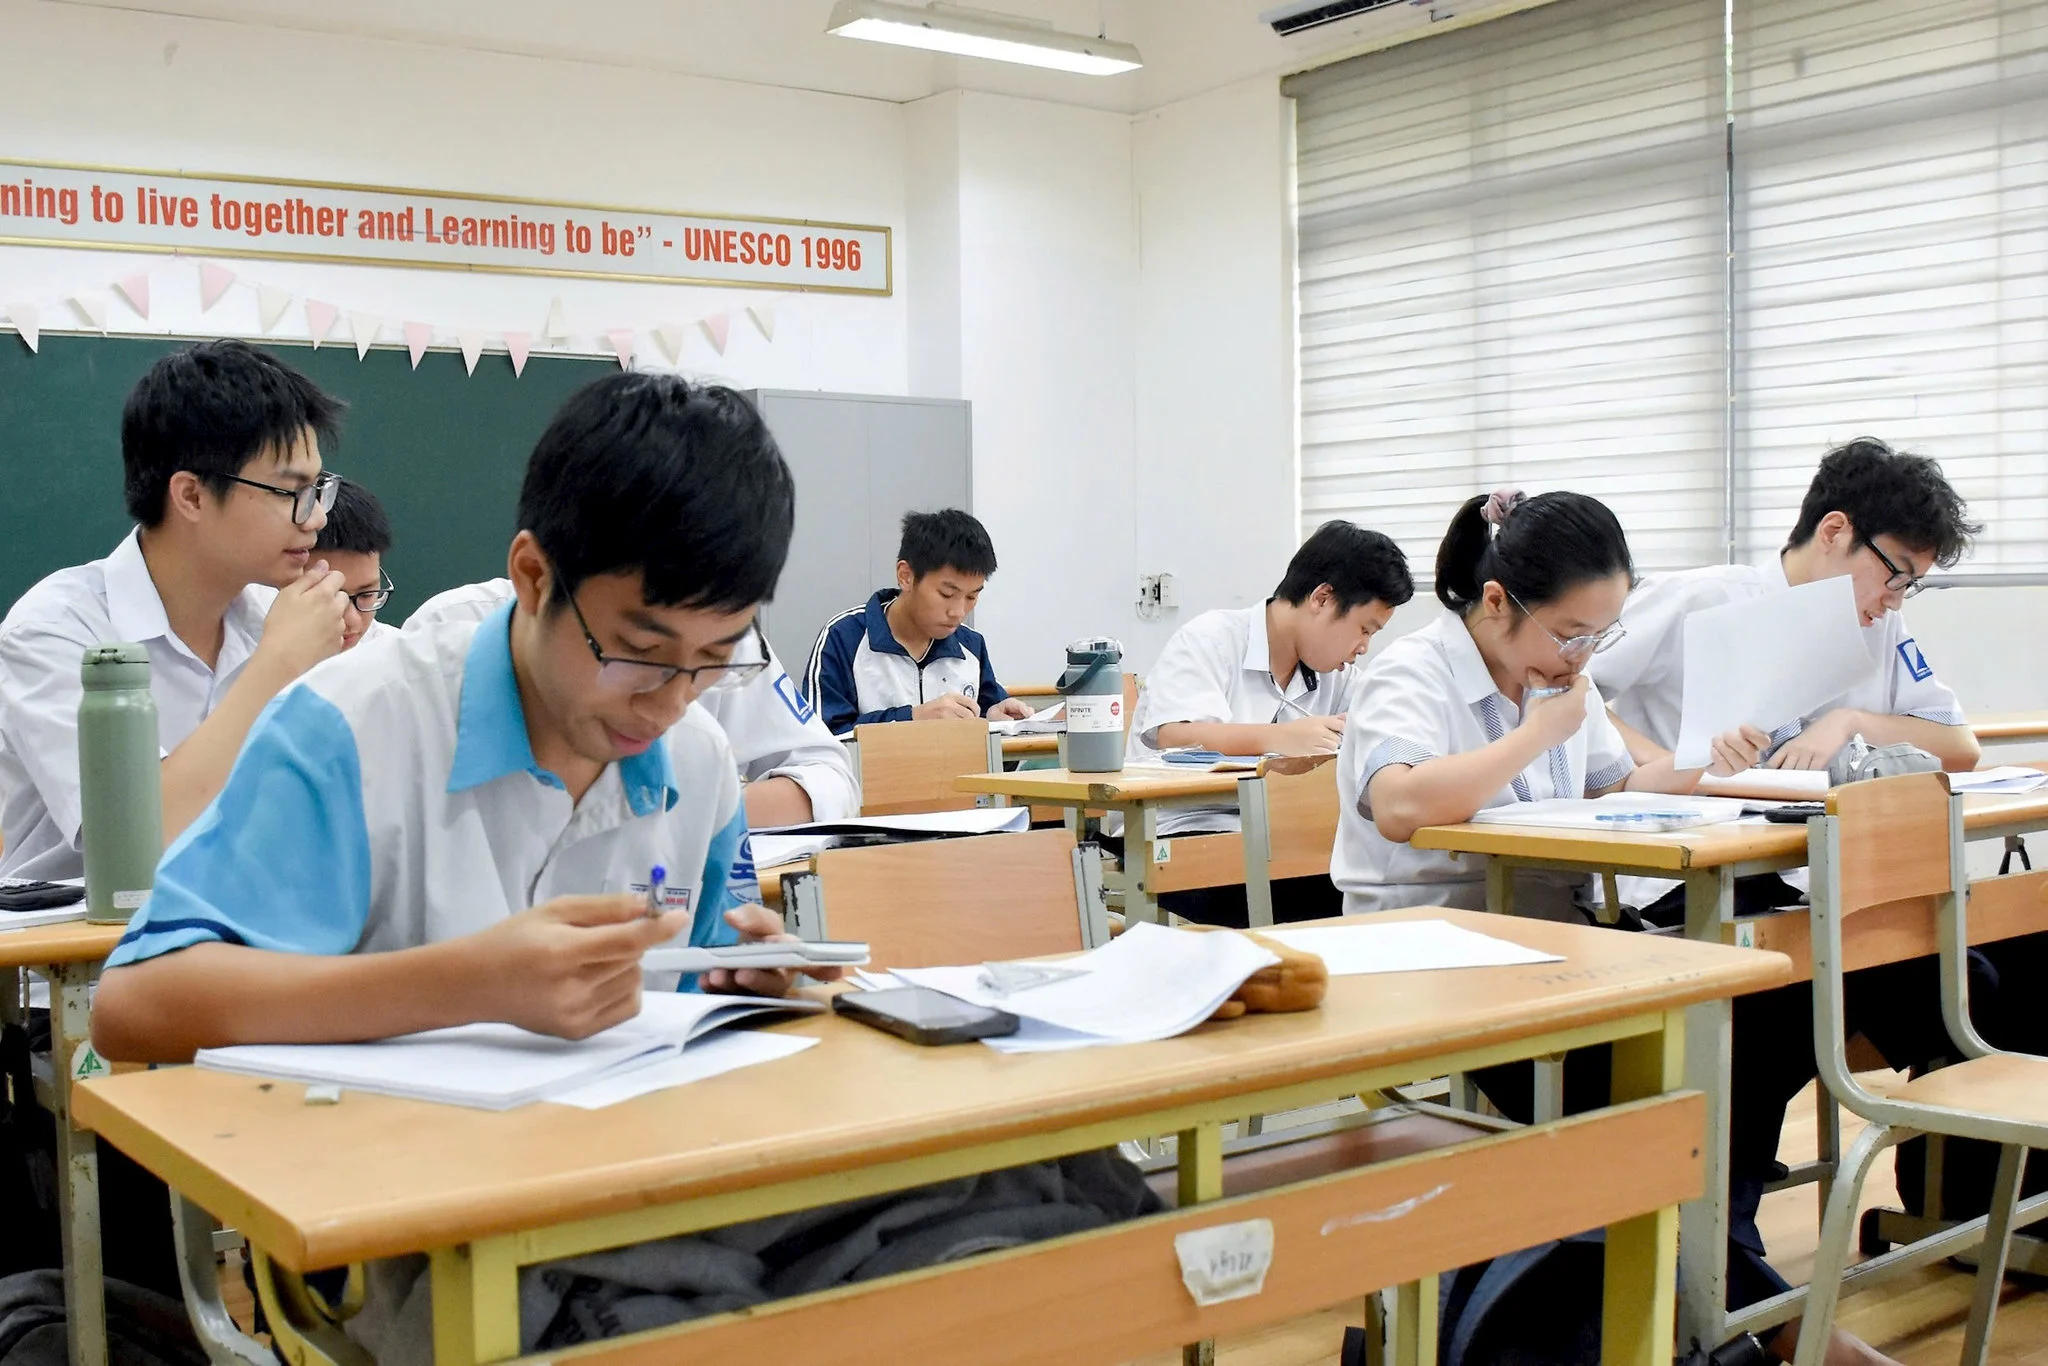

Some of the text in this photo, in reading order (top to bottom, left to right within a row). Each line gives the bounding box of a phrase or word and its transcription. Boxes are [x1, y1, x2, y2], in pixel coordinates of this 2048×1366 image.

[0, 179, 79, 225] ning
[91, 185, 124, 223] to
[138, 187, 199, 228] live
[210, 193, 349, 237] together
[358, 206, 414, 242] and
[425, 208, 556, 256] Learning
[565, 219, 592, 254] to
[684, 227, 792, 267] UNESCO
[801, 236, 862, 272] 1996
